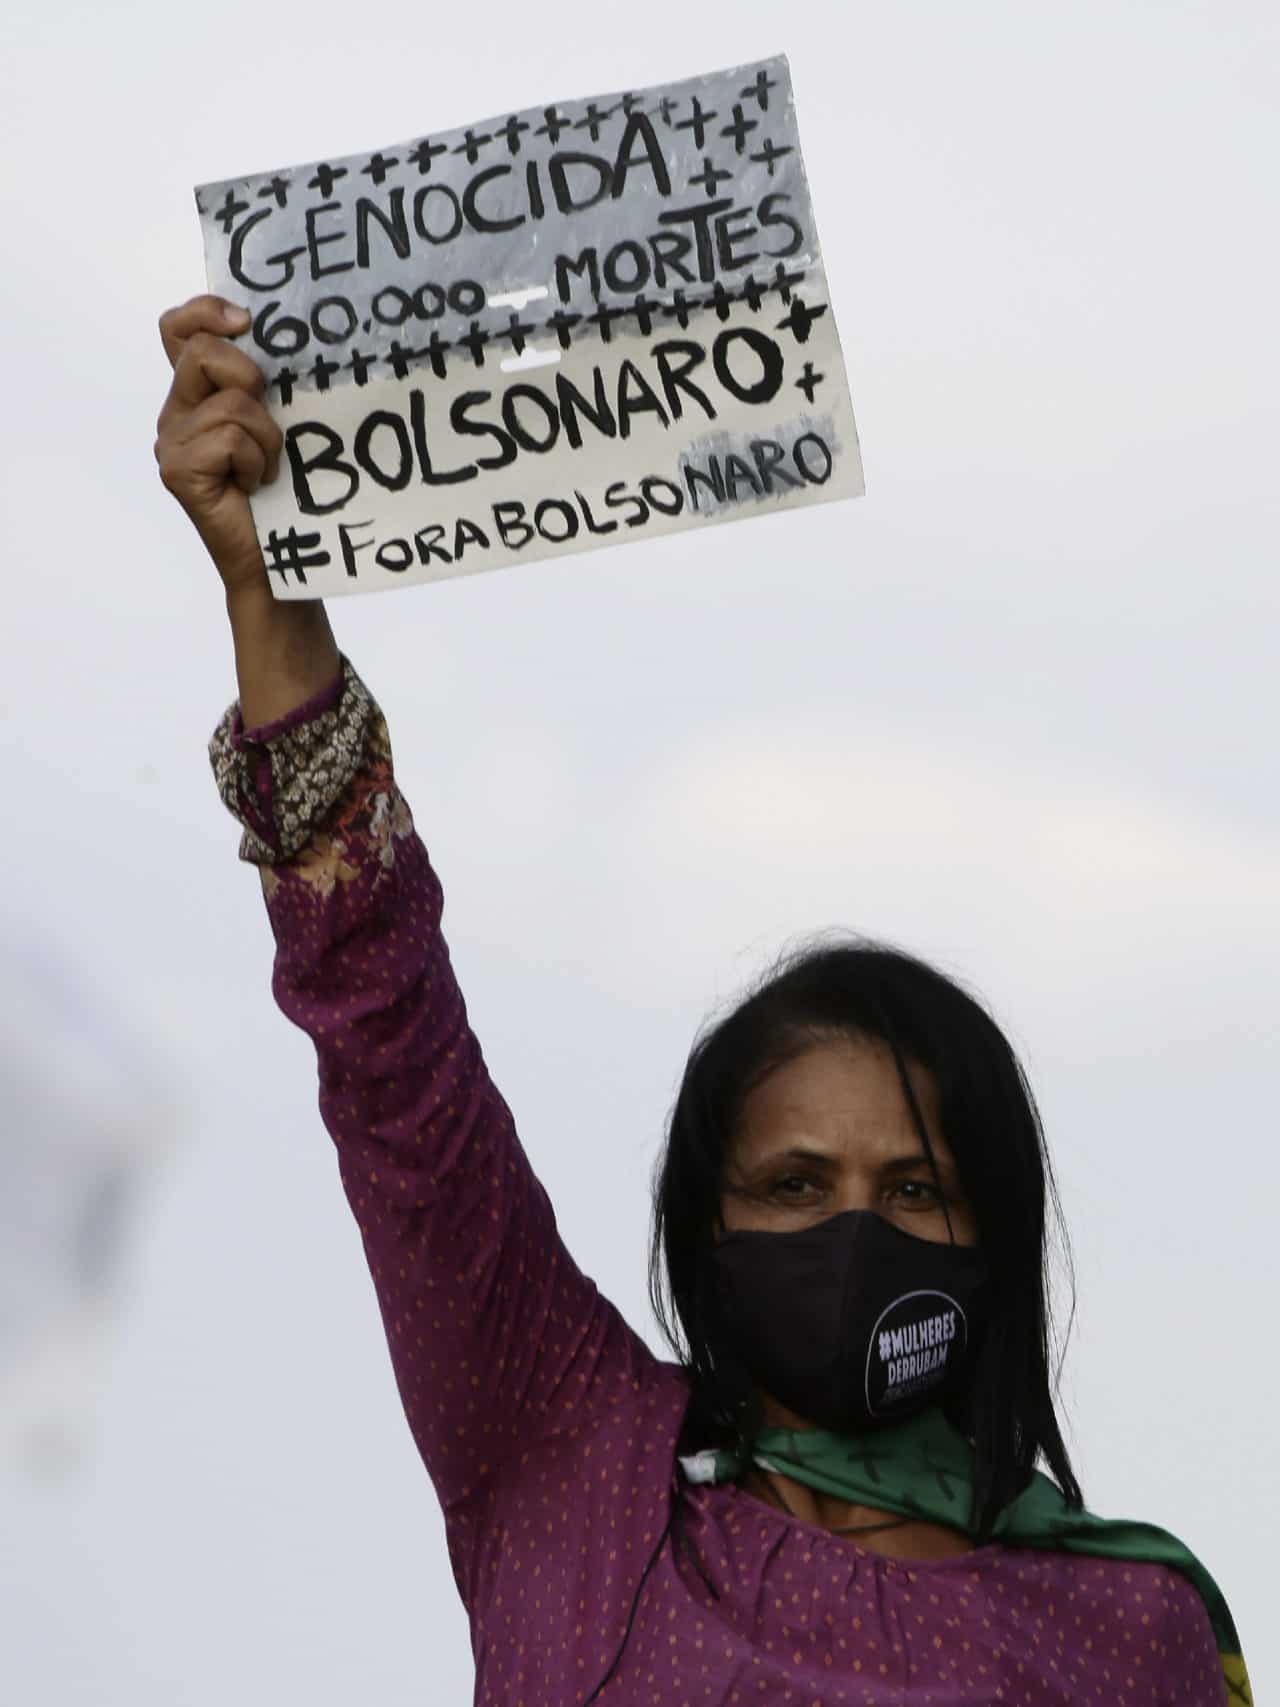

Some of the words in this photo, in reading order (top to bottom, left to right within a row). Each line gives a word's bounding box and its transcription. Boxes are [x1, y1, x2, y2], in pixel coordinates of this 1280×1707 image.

[229, 112, 670, 292] GENOCIDA
[252, 280, 485, 357] 60.000
[556, 194, 803, 302] MORTES
[284, 327, 784, 516] BOLSONARO
[879, 1311, 955, 1361] #MULHERES
[888, 1343, 948, 1386] DERRUBAM
